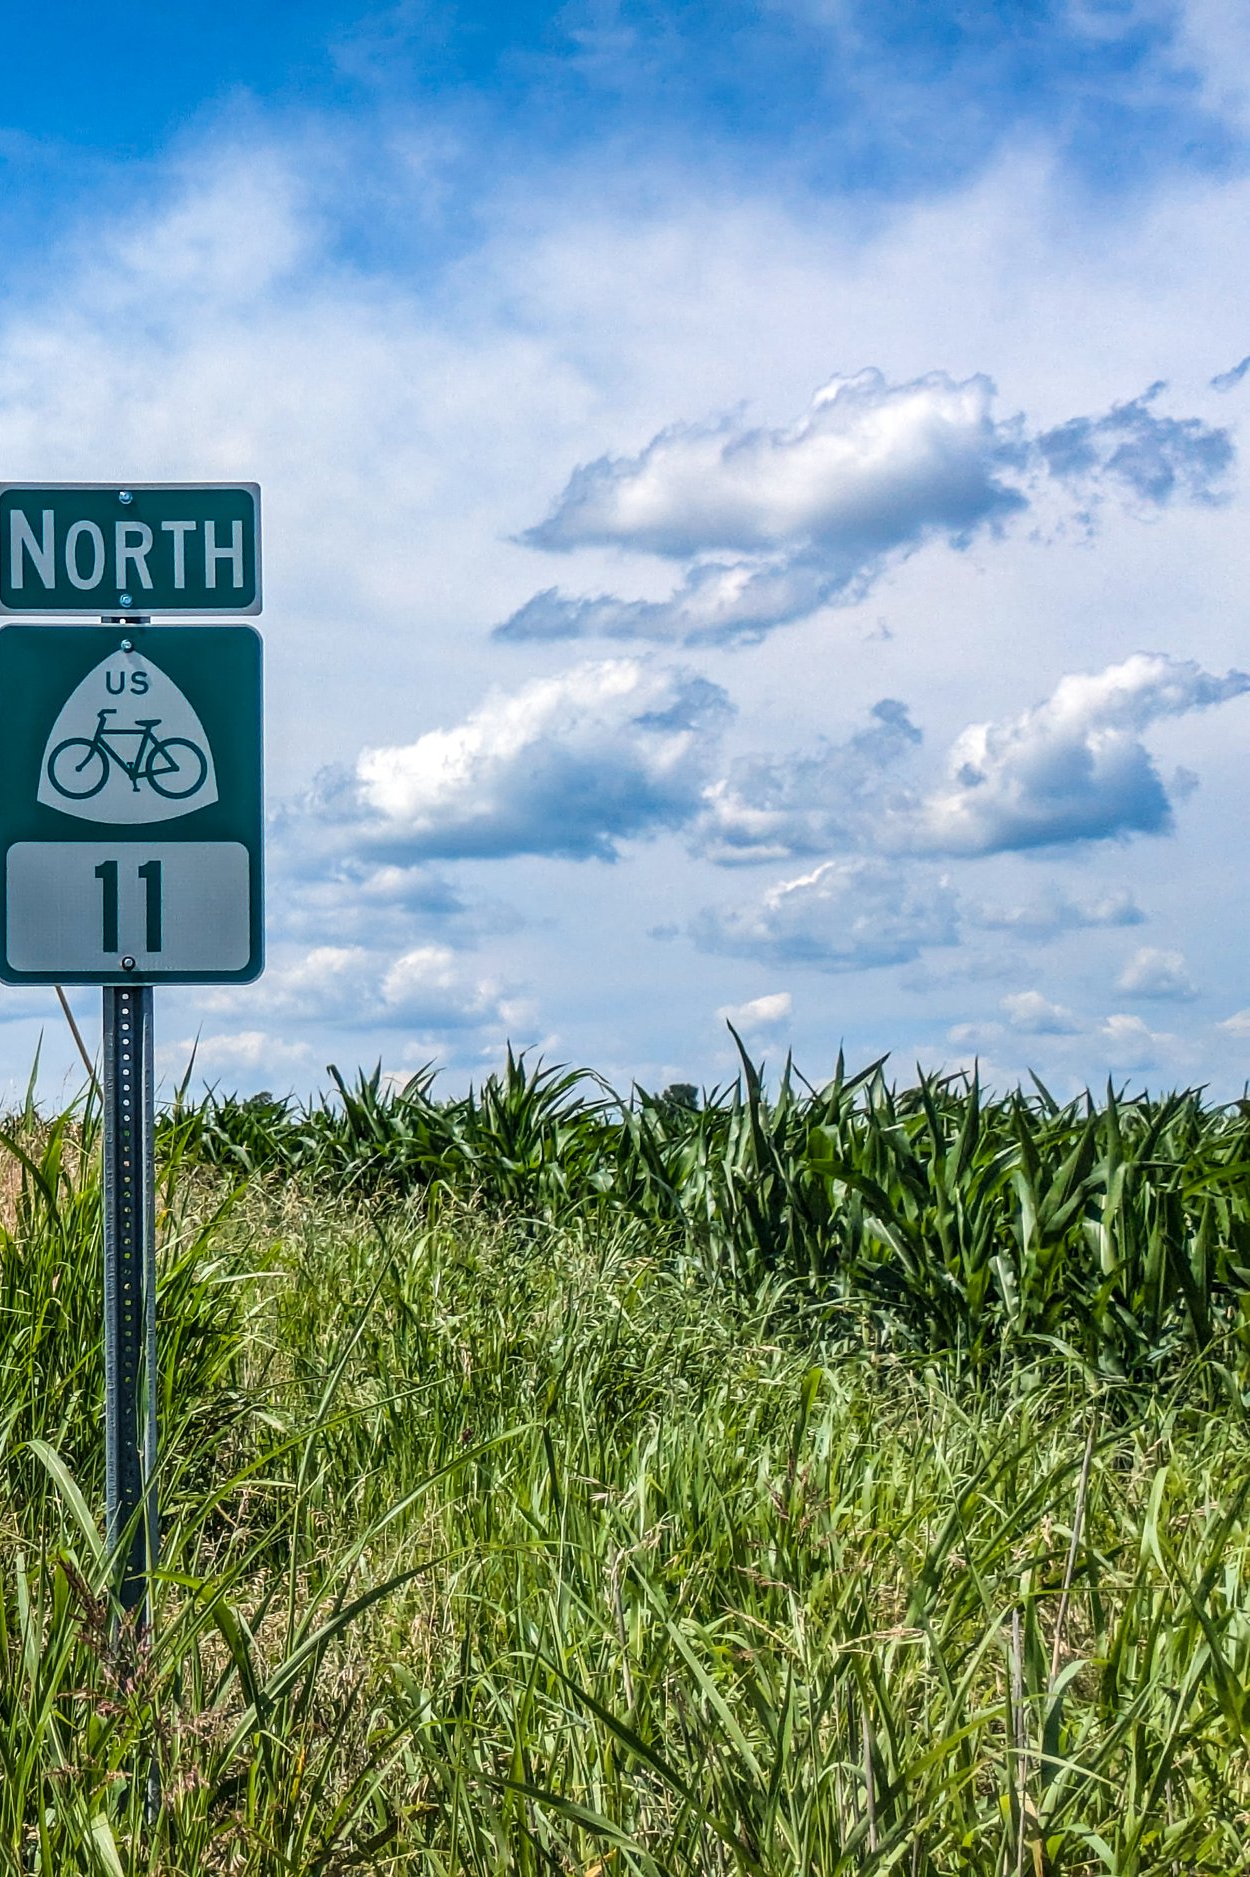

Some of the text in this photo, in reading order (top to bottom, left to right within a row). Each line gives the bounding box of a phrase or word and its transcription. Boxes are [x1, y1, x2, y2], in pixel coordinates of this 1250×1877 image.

[9, 509, 244, 590] NORTH
[105, 671, 149, 695] US
[94, 860, 162, 953] 11
